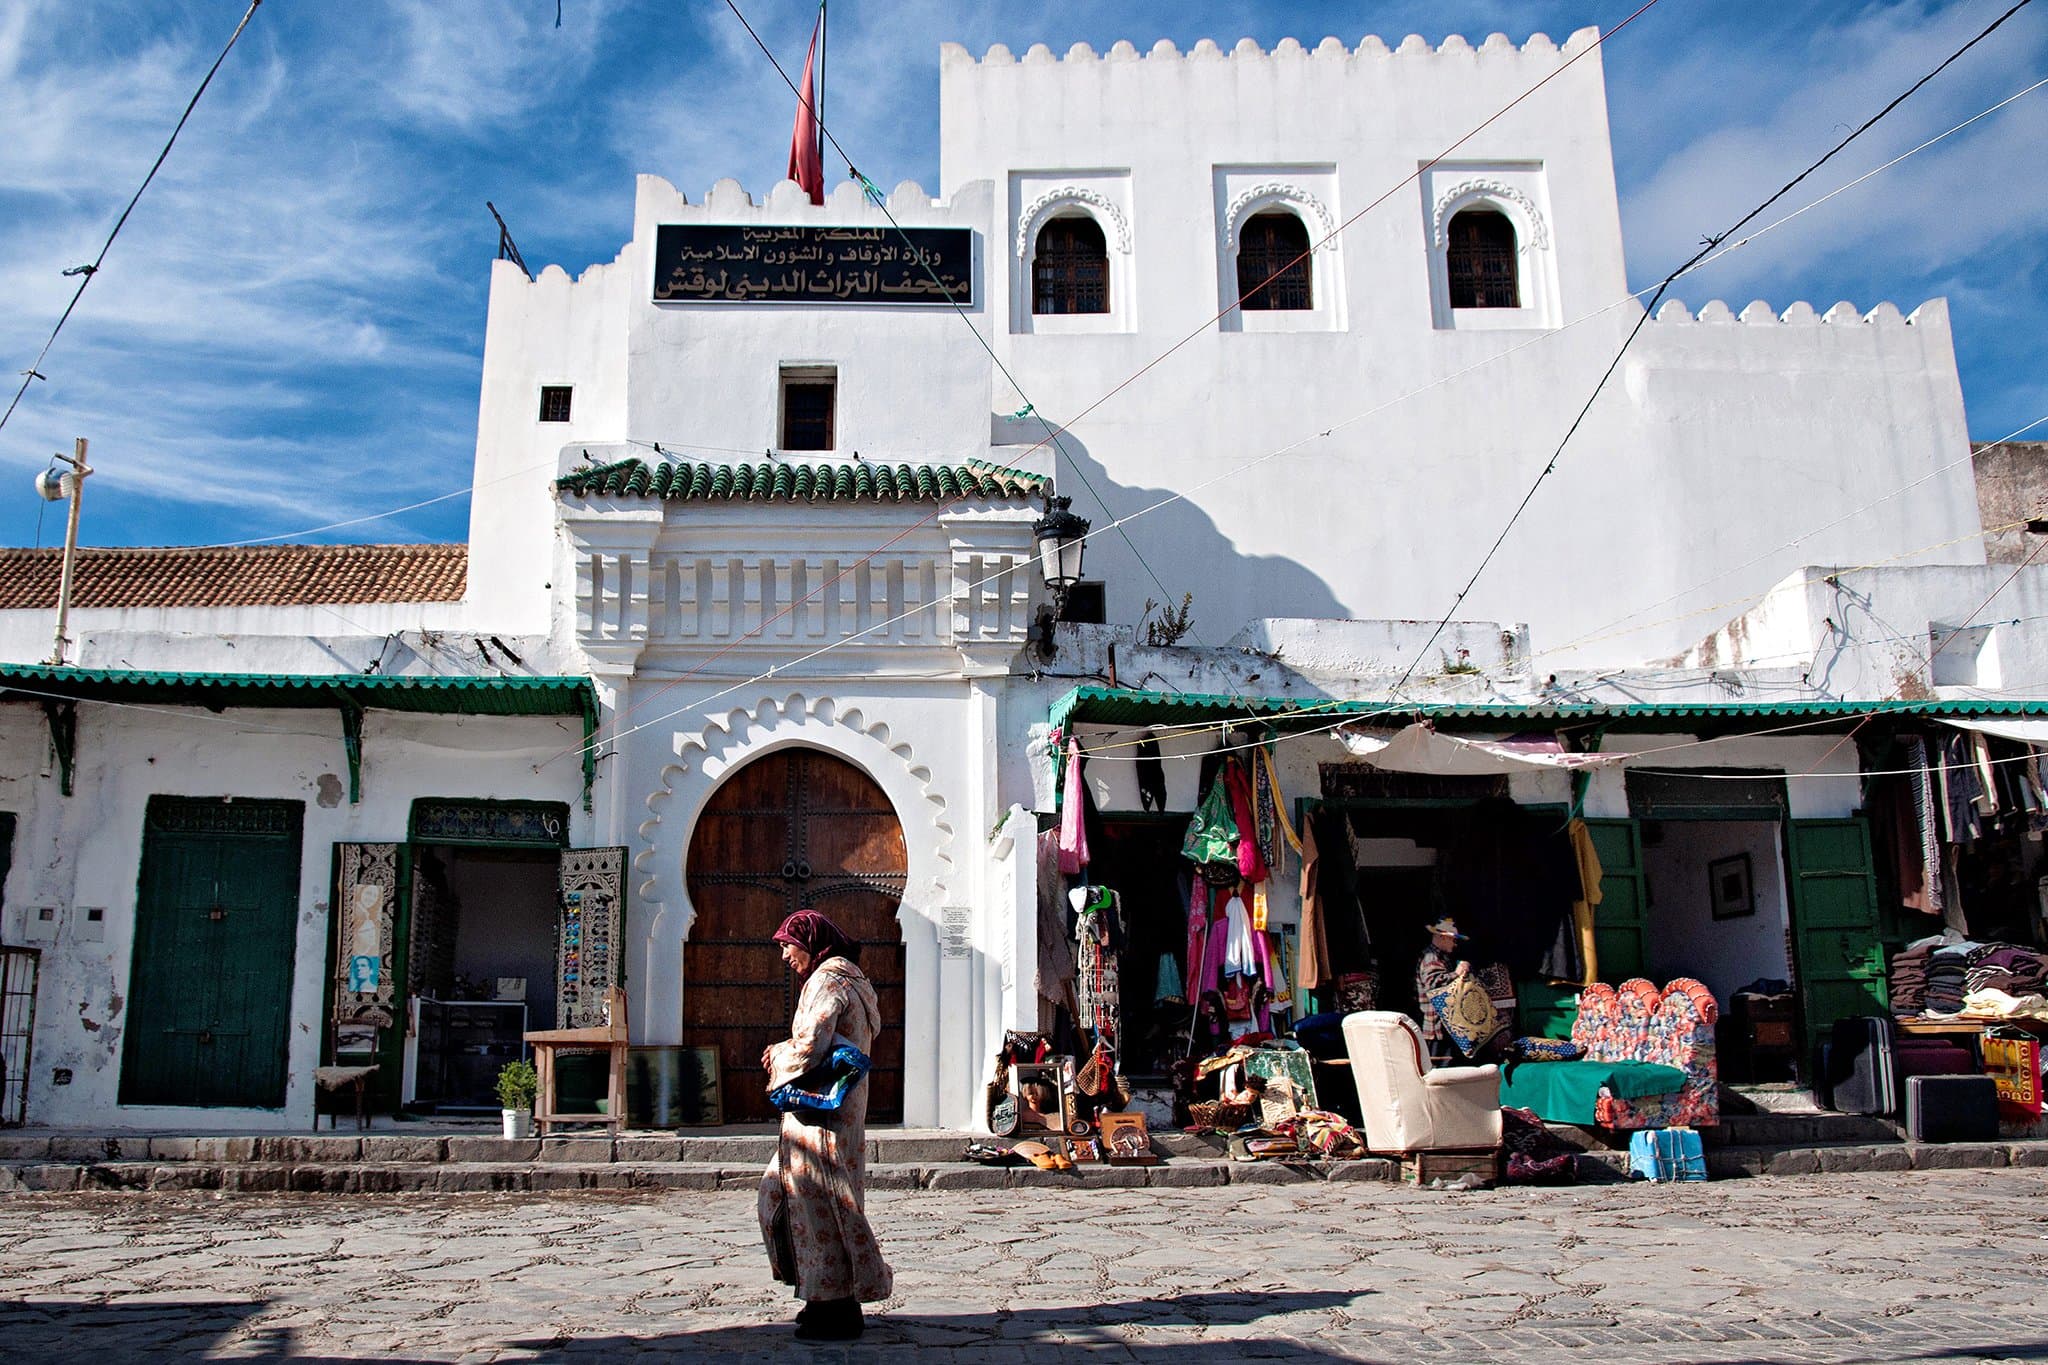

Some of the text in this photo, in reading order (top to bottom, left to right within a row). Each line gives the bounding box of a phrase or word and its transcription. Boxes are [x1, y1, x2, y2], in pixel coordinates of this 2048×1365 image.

[743, 226, 885, 242] المملكة المغربية
[902, 246, 941, 266] وزارة
[655, 267, 968, 301] متحف التراث الديني لوقش
